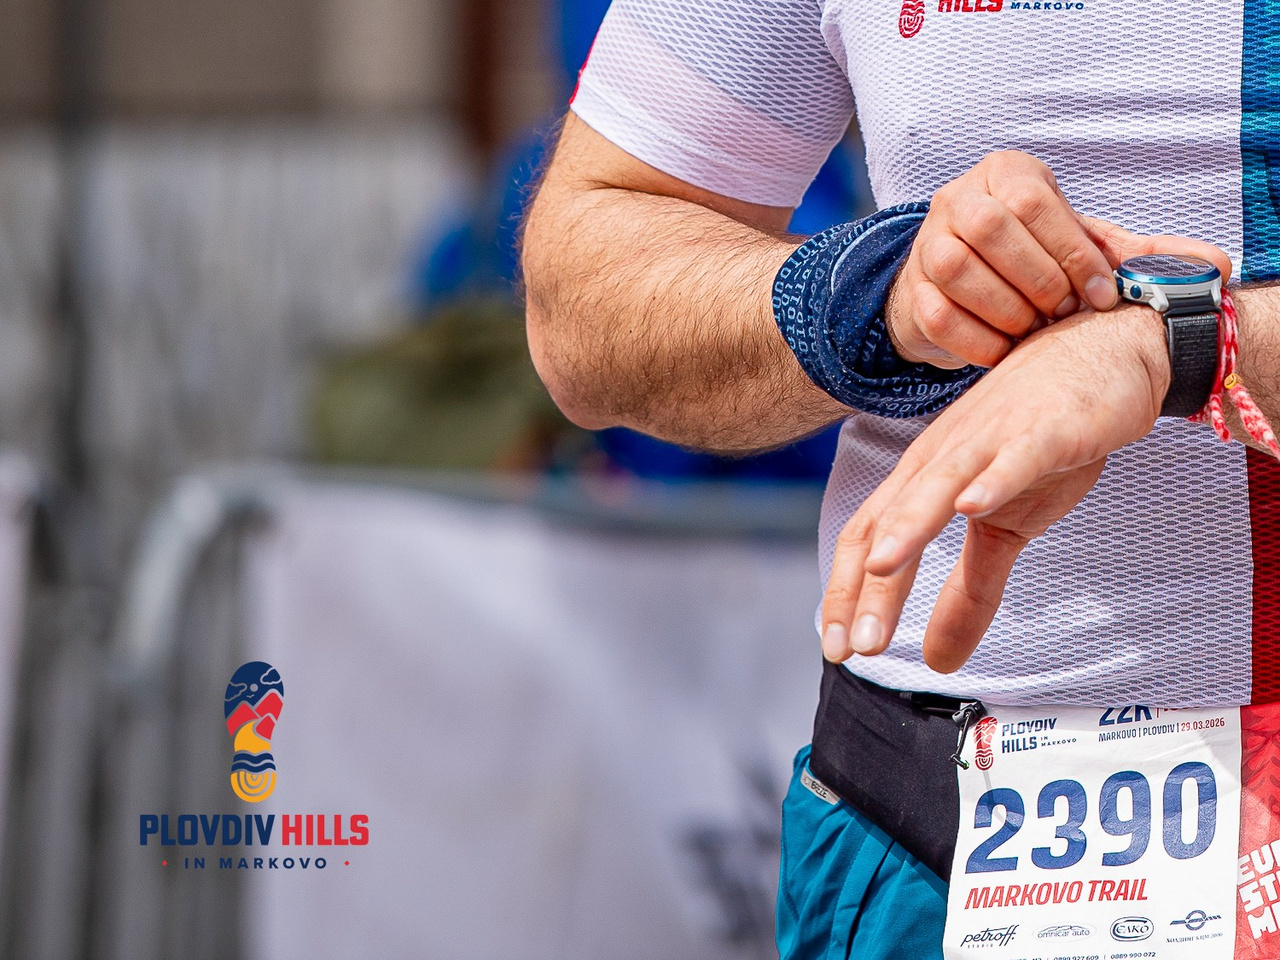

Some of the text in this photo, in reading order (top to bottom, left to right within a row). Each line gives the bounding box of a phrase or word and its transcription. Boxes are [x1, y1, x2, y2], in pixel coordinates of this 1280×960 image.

[1010, 2, 1085, 10] MARKOVO
[1002, 718, 1057, 737] PLOVDIV
[1098, 717, 1226, 742] MARKOVO PLOVDIV 29.03.2026
[1002, 736, 1038, 754] HILLS
[1041, 737, 1077, 746] MARKOVO
[965, 761, 1218, 874] 2390
[964, 878, 1149, 910] MARKOVO TRAIL
[1072, 928, 1090, 936] auto
